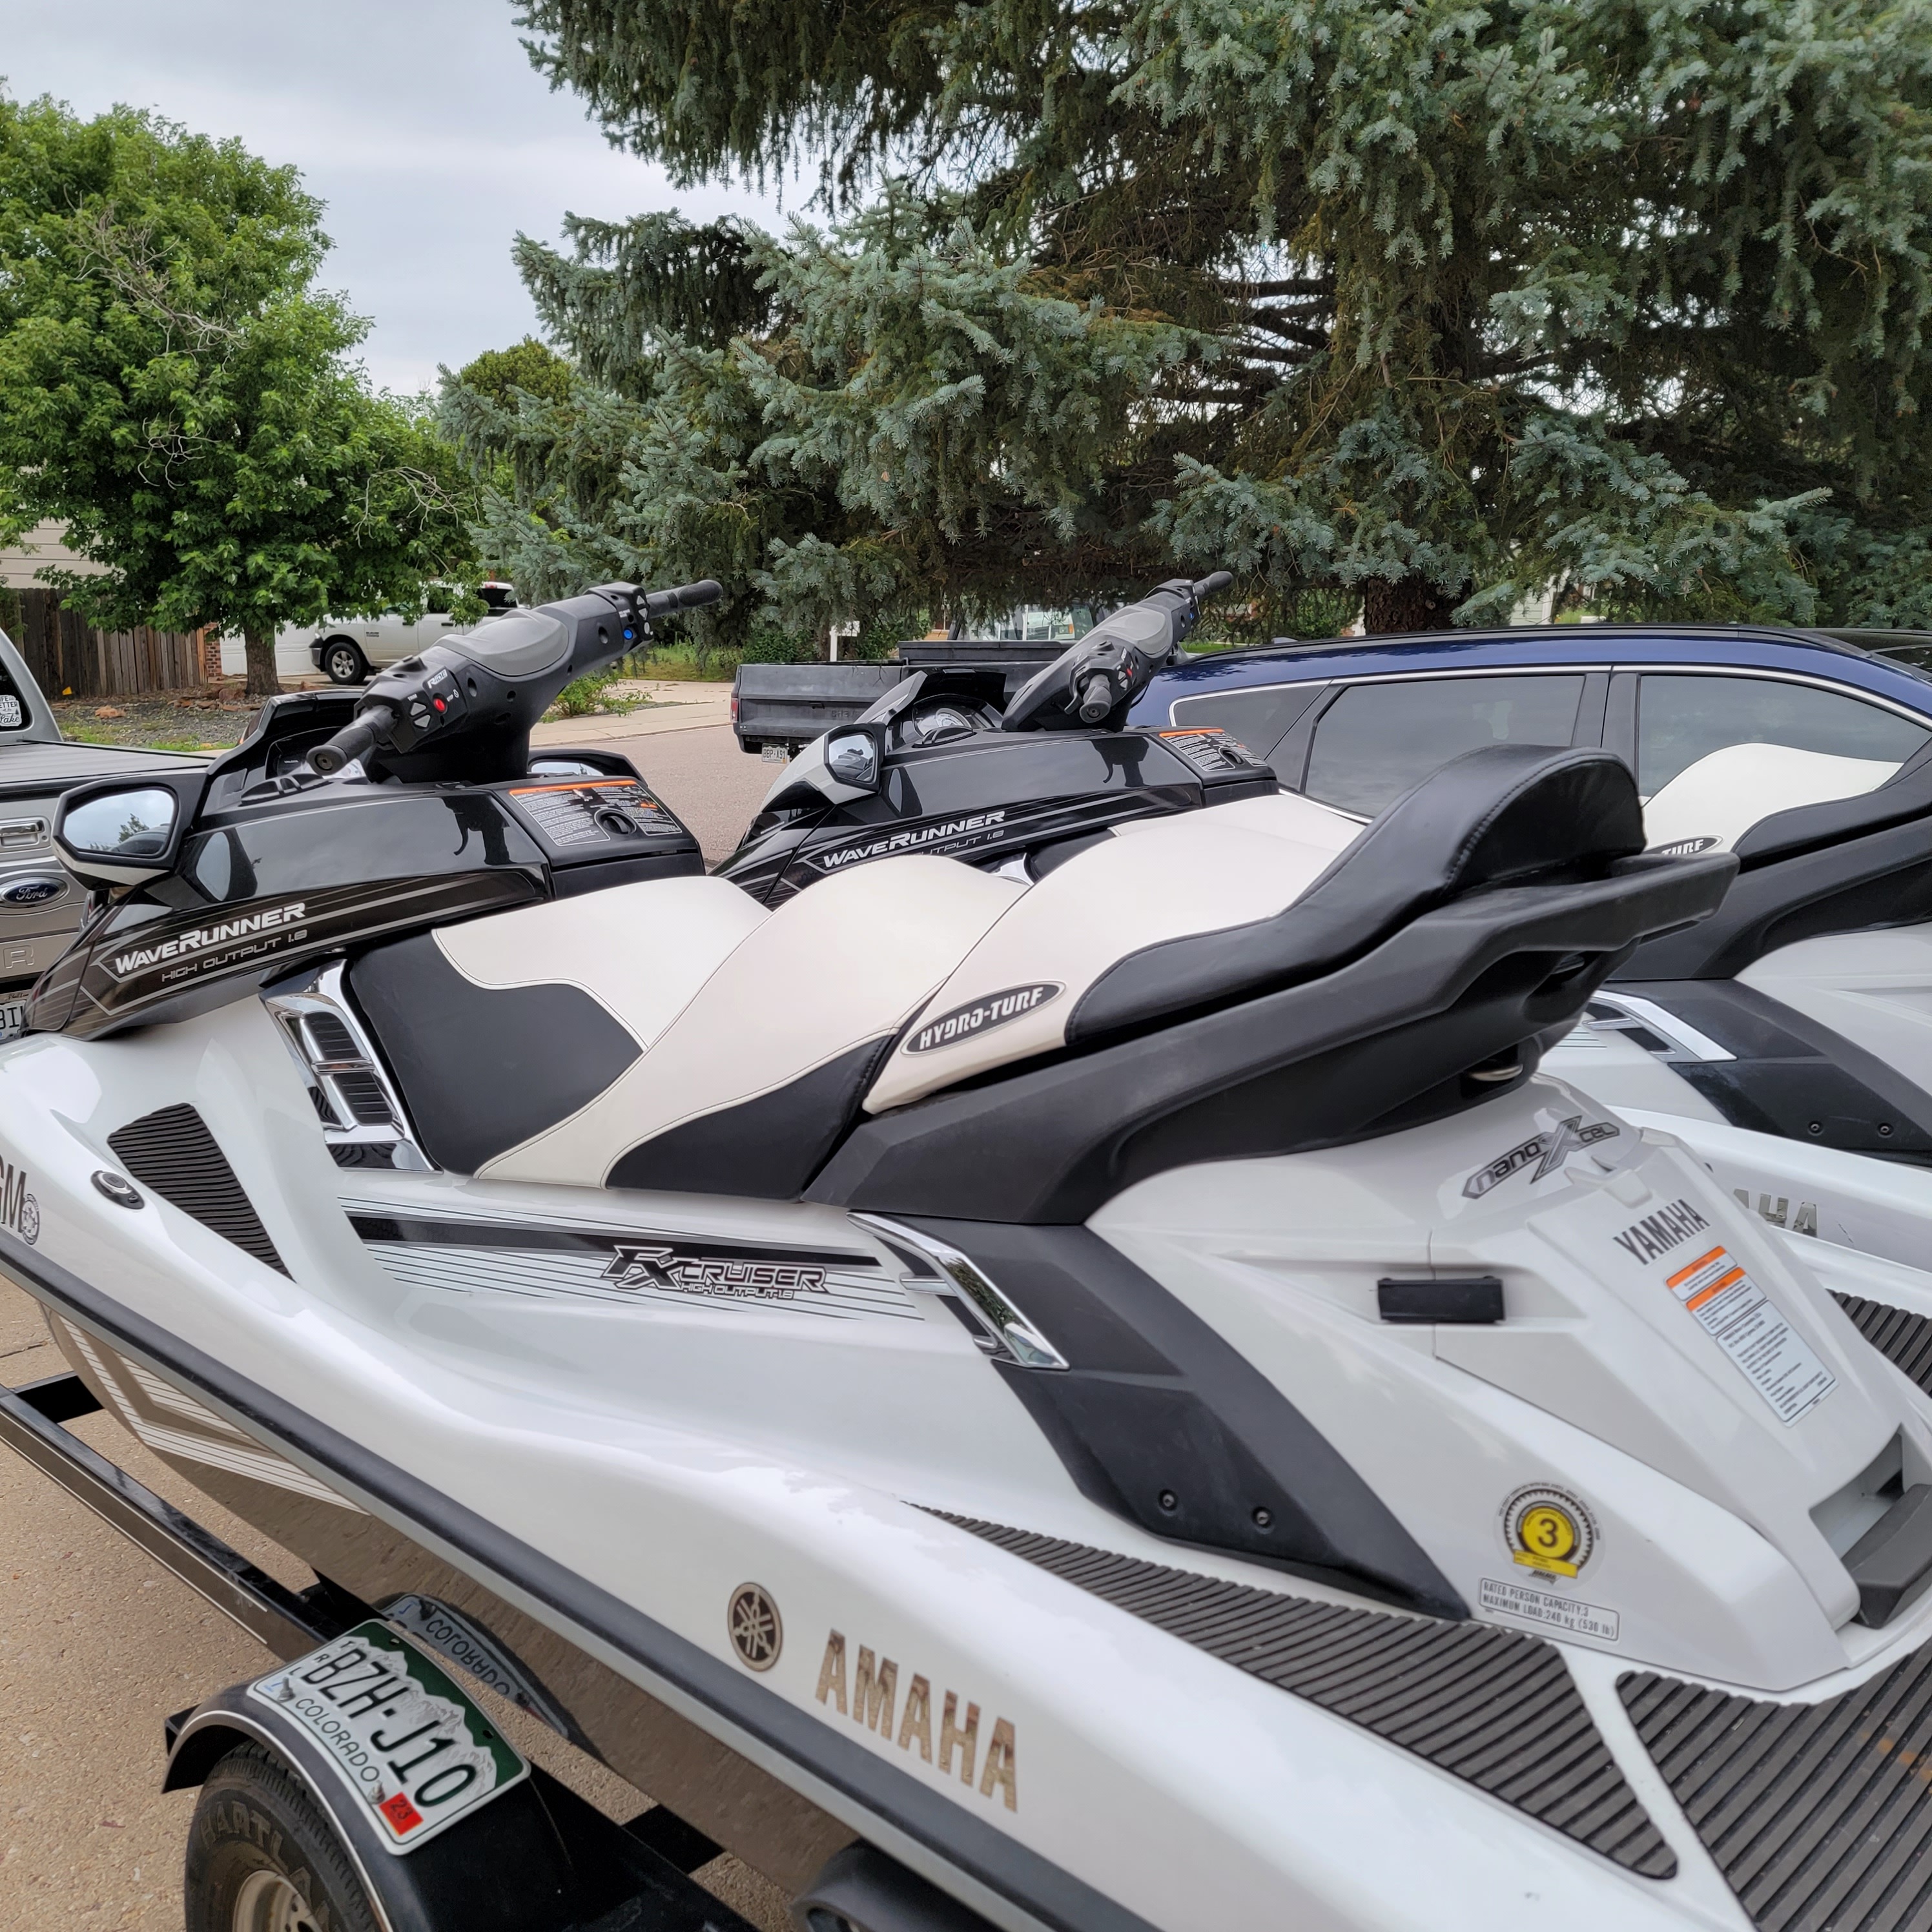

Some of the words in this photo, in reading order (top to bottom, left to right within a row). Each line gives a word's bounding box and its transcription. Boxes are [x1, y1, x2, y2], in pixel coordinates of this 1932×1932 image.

[987, 830, 1004, 840] 1.8
[16, 885, 48, 901] Ford
[161, 963, 198, 982] HIGH
[203, 937, 282, 969] OUTPUT
[288, 929, 308, 943] 1.8
[919, 987, 1044, 1050] HYDRO-TURF
[1612, 1198, 1711, 1266] YAMAHA
[680, 1261, 830, 1294] CRUISER
[1537, 1518, 1559, 1548] 3
[1484, 1582, 1506, 1596] RATED
[1510, 1588, 1540, 1604] PERSON
[1483, 1594, 1520, 1610] MAXIMUM
[1565, 1615, 1575, 1629] kg
[815, 1628, 1018, 1814] AMAHA
[294, 1698, 381, 1783] COLORADO
[389, 1798, 414, 1821] 23
